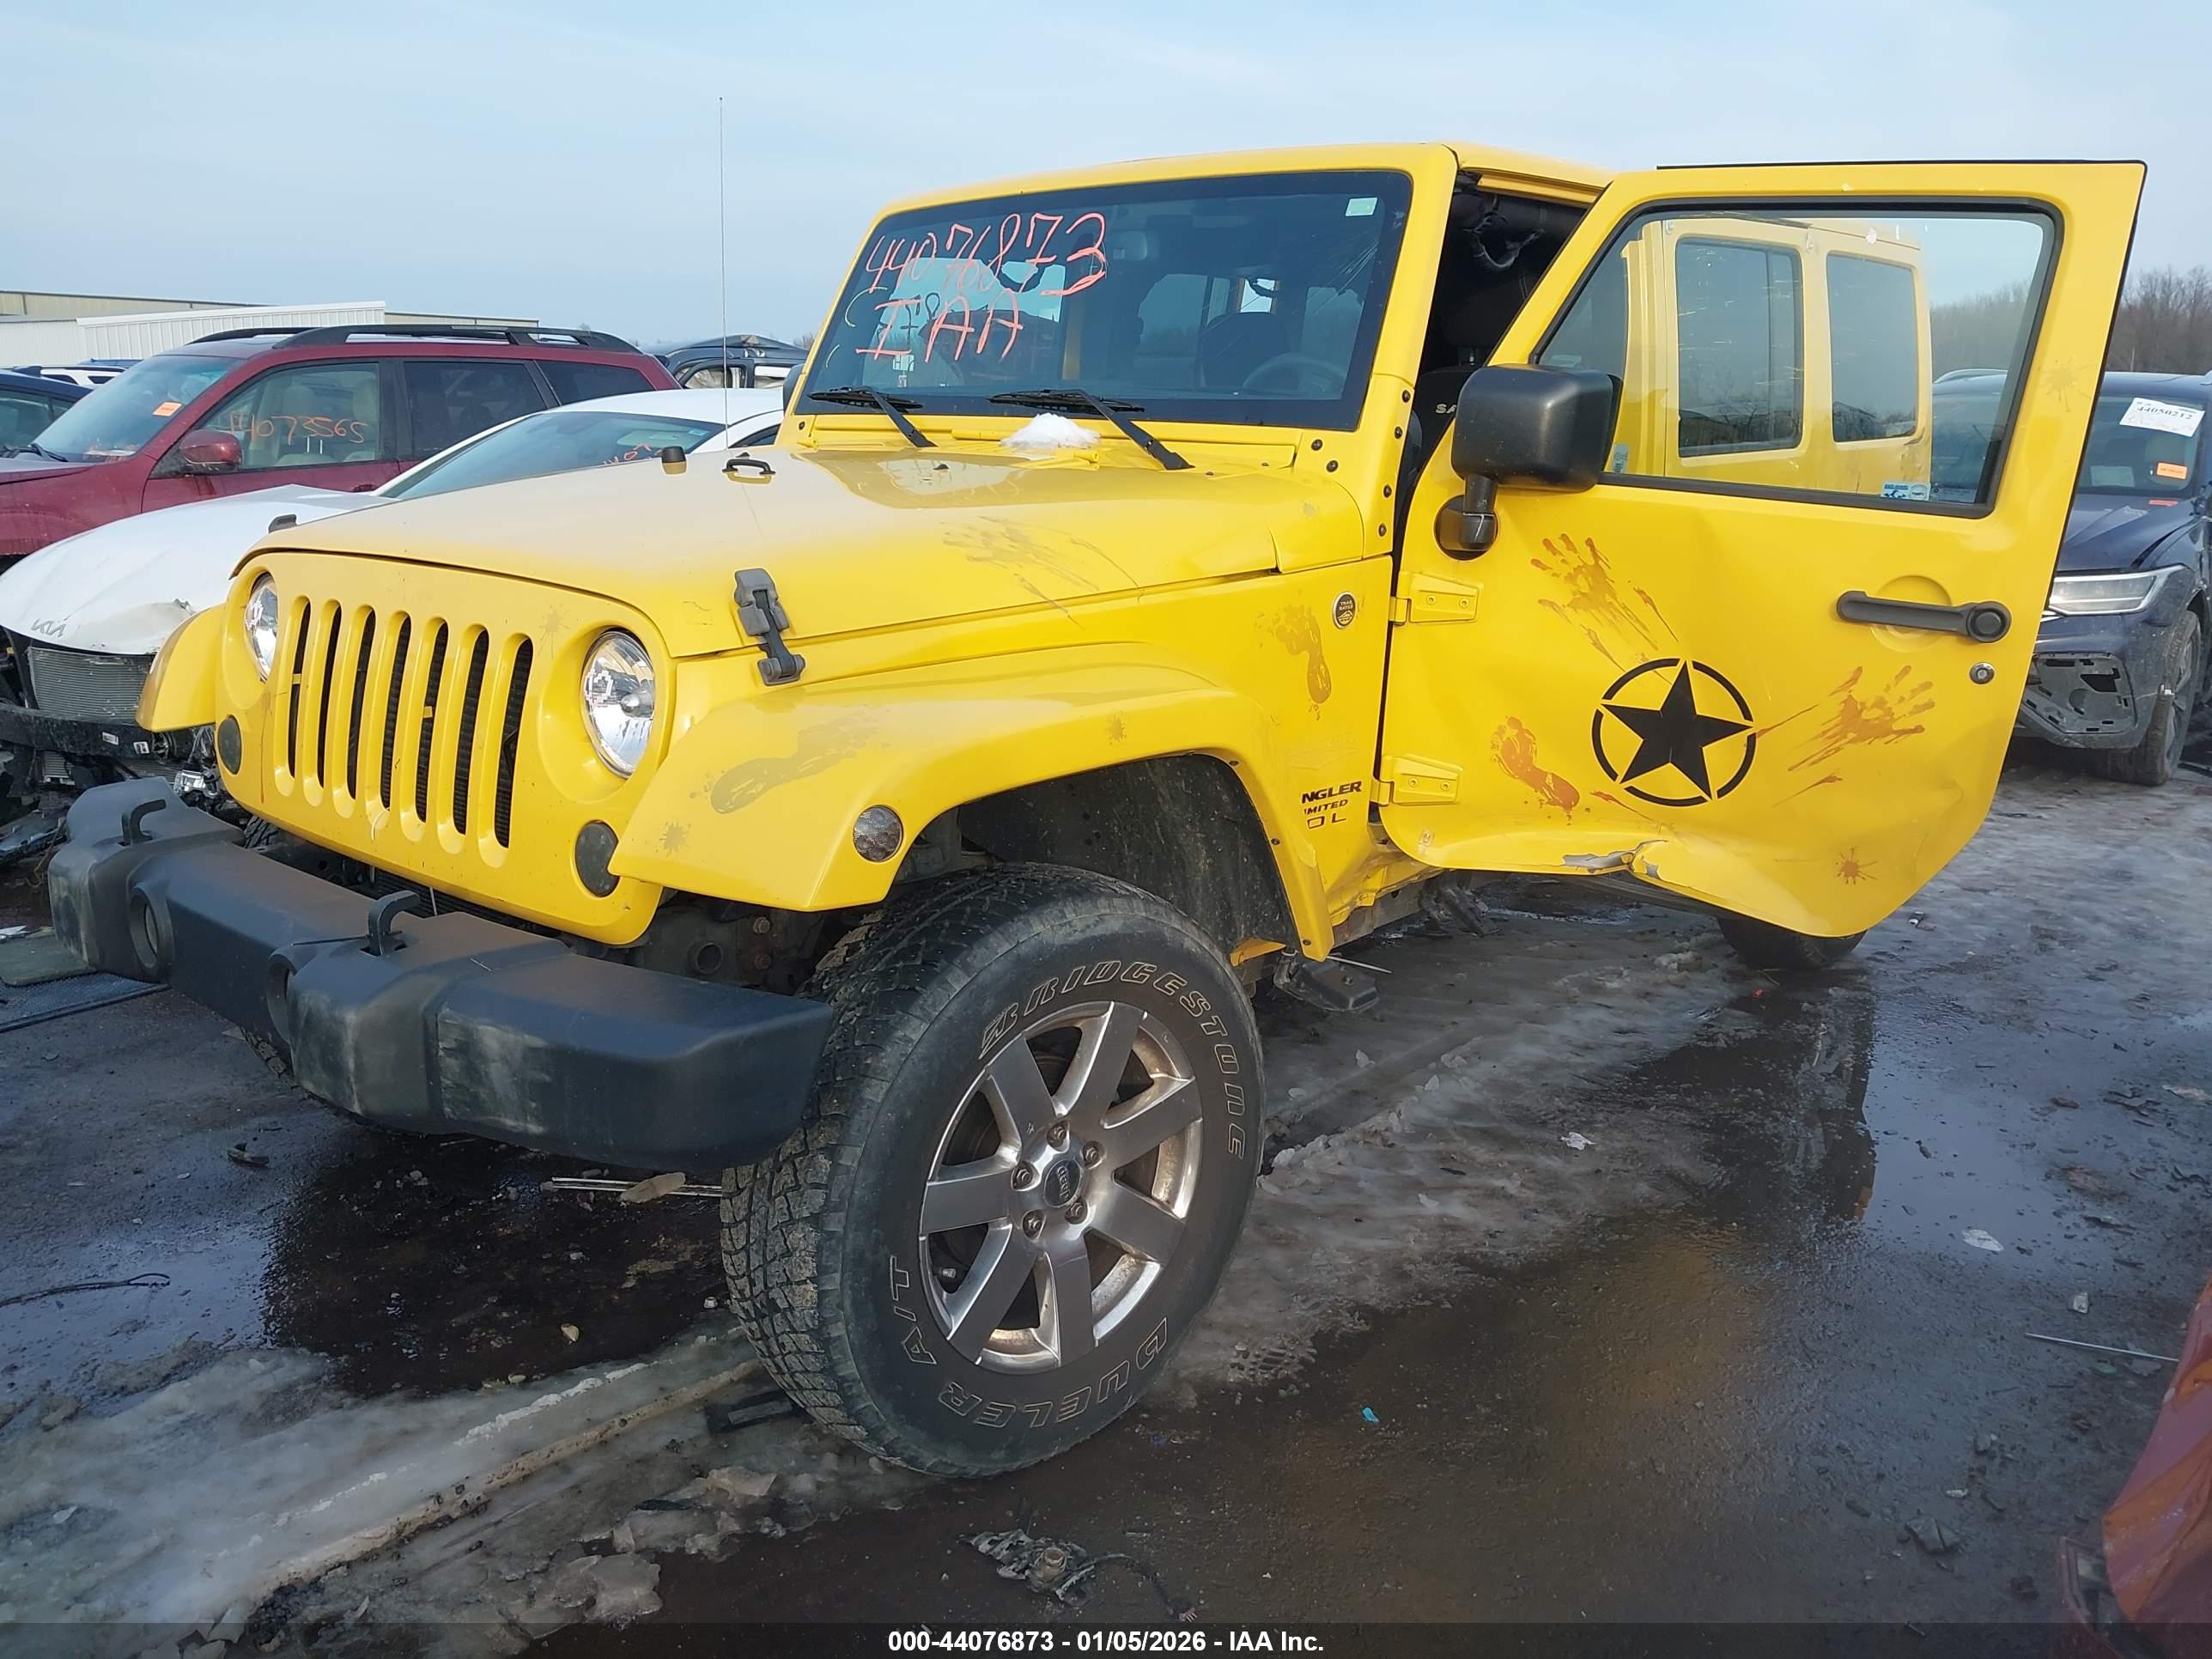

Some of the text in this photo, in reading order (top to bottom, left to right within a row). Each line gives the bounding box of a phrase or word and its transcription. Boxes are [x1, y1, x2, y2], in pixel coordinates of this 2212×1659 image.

[866, 212, 1107, 295] 44076873
[855, 288, 1024, 363] IAA
[31, 618, 67, 637] KIA
[1301, 781, 1362, 805] NGLER
[978, 960, 1246, 1160] BRIDGESTONE
[889, 1255, 1168, 1429] DUELER A/T
